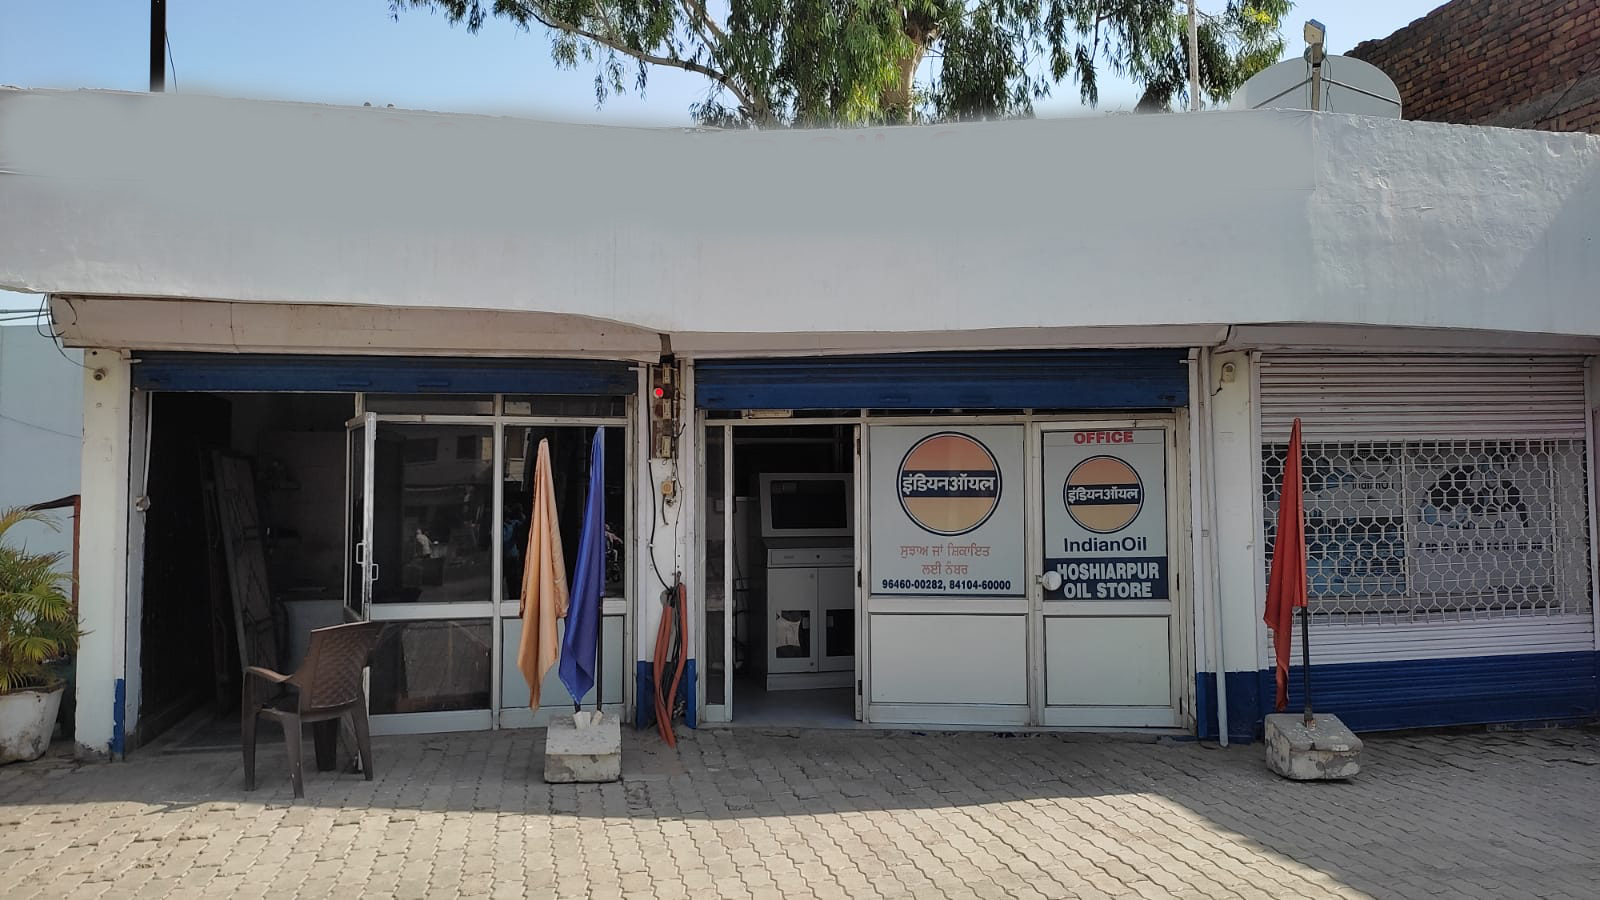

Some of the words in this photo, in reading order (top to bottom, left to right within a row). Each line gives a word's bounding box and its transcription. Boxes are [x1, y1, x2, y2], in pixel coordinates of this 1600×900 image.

[1074, 431, 1134, 445] OFFICE
[902, 473, 996, 495] इंडियनऑयल
[1067, 486, 1139, 504] इंडियनऑयल
[1064, 536, 1147, 552] IndianOil
[1057, 563, 1159, 580] HOSHIARPUR
[882, 580, 946, 591] 96460-00282,
[949, 580, 1011, 590] 84104-60000
[1064, 583, 1091, 599] OIL
[1097, 582, 1152, 598] STORE
